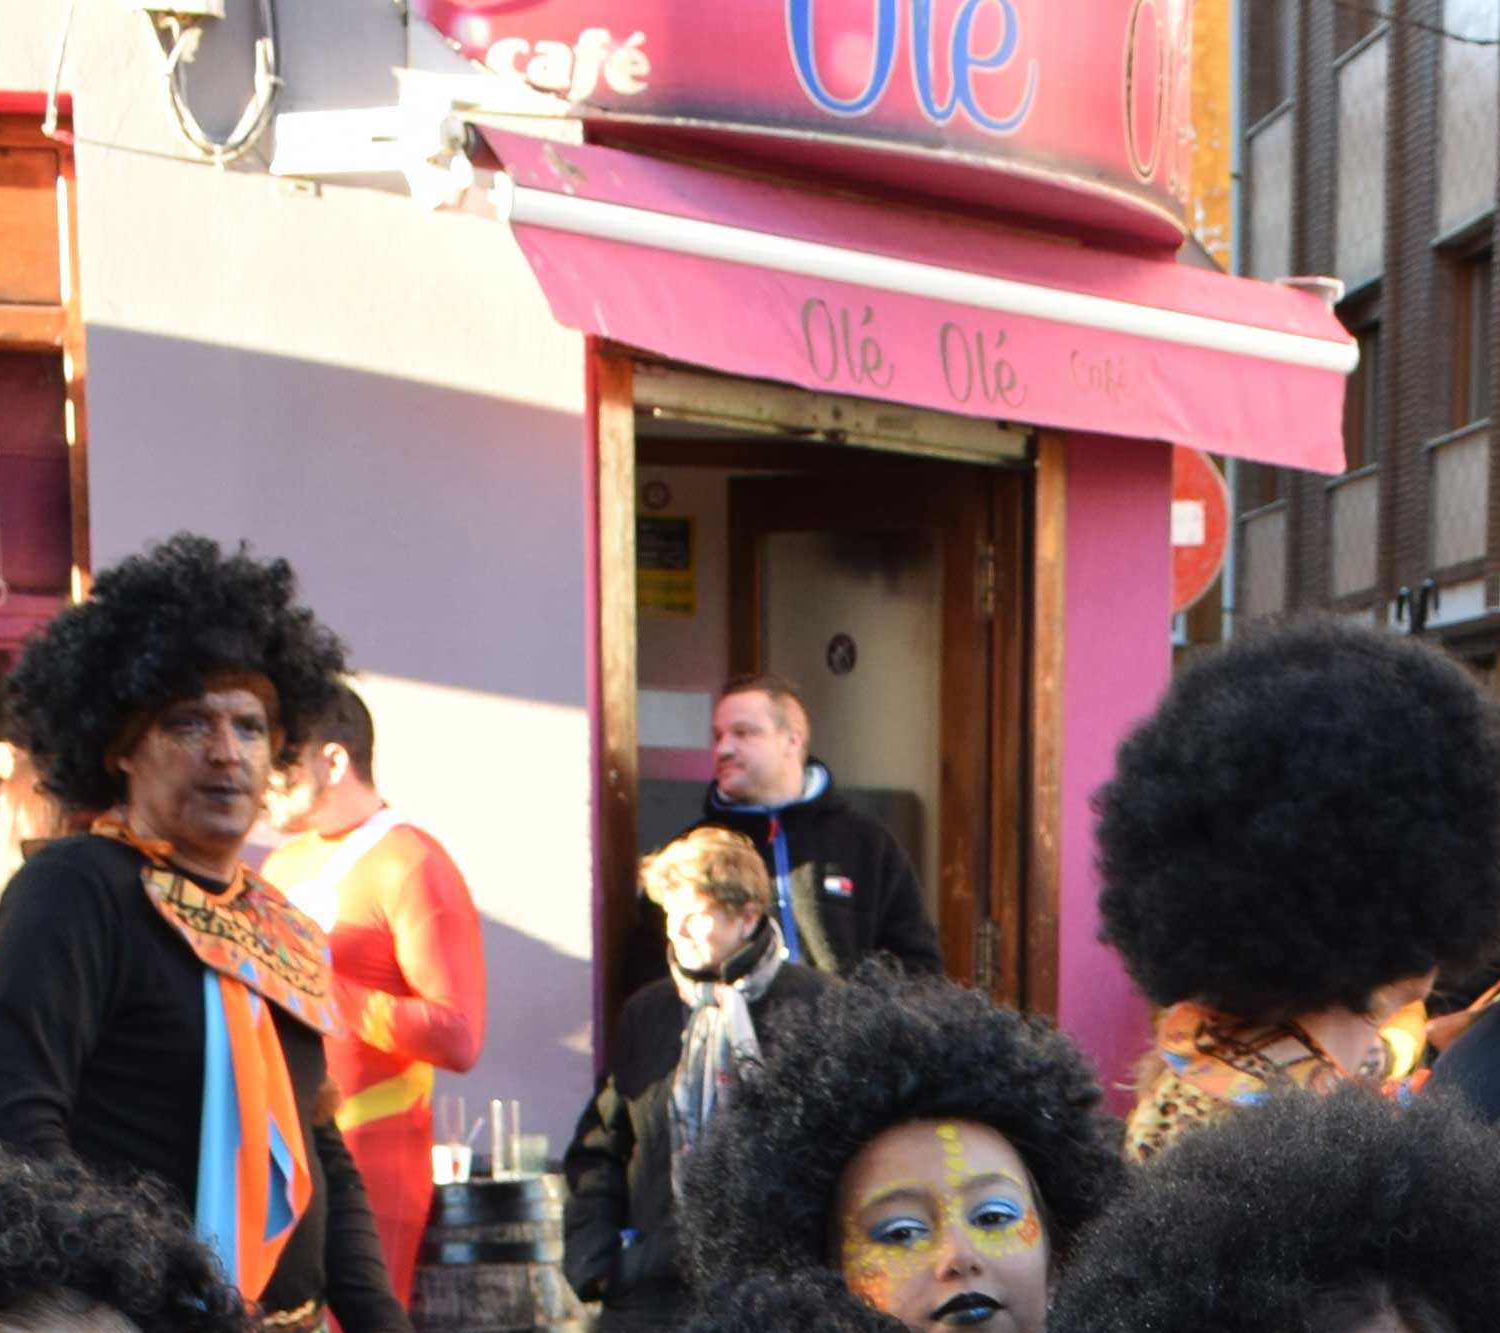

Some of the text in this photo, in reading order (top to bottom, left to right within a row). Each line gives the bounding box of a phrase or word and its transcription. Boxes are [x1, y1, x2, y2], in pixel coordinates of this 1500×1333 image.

[485, 27, 651, 101] café
[801, 297, 895, 390] Olé
[938, 320, 1029, 409] Olé
